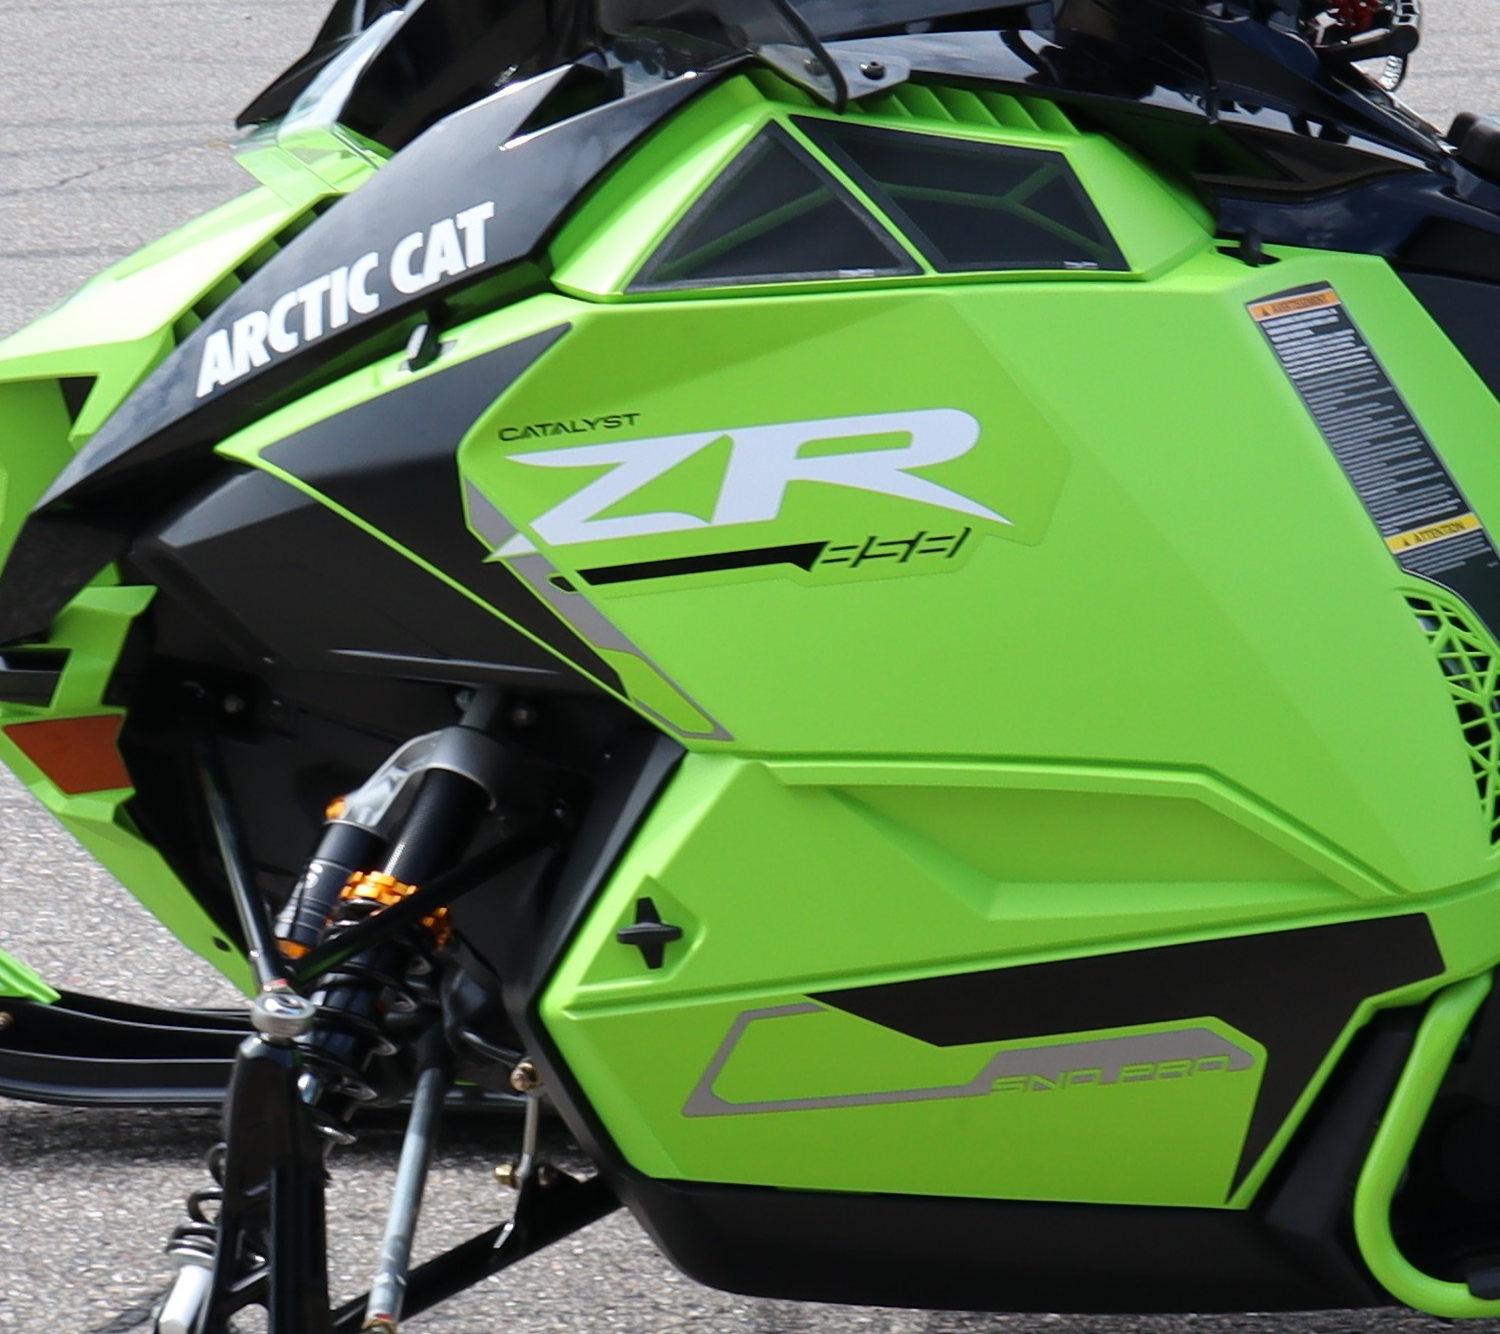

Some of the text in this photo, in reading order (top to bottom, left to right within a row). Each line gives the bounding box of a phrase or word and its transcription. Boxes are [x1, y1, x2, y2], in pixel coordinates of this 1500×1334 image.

[195, 200, 495, 398] ARCTIC CAT
[498, 412, 641, 441] CATALYST
[482, 407, 1016, 564] ZR
[989, 1054, 1231, 1092] SNO PRO
